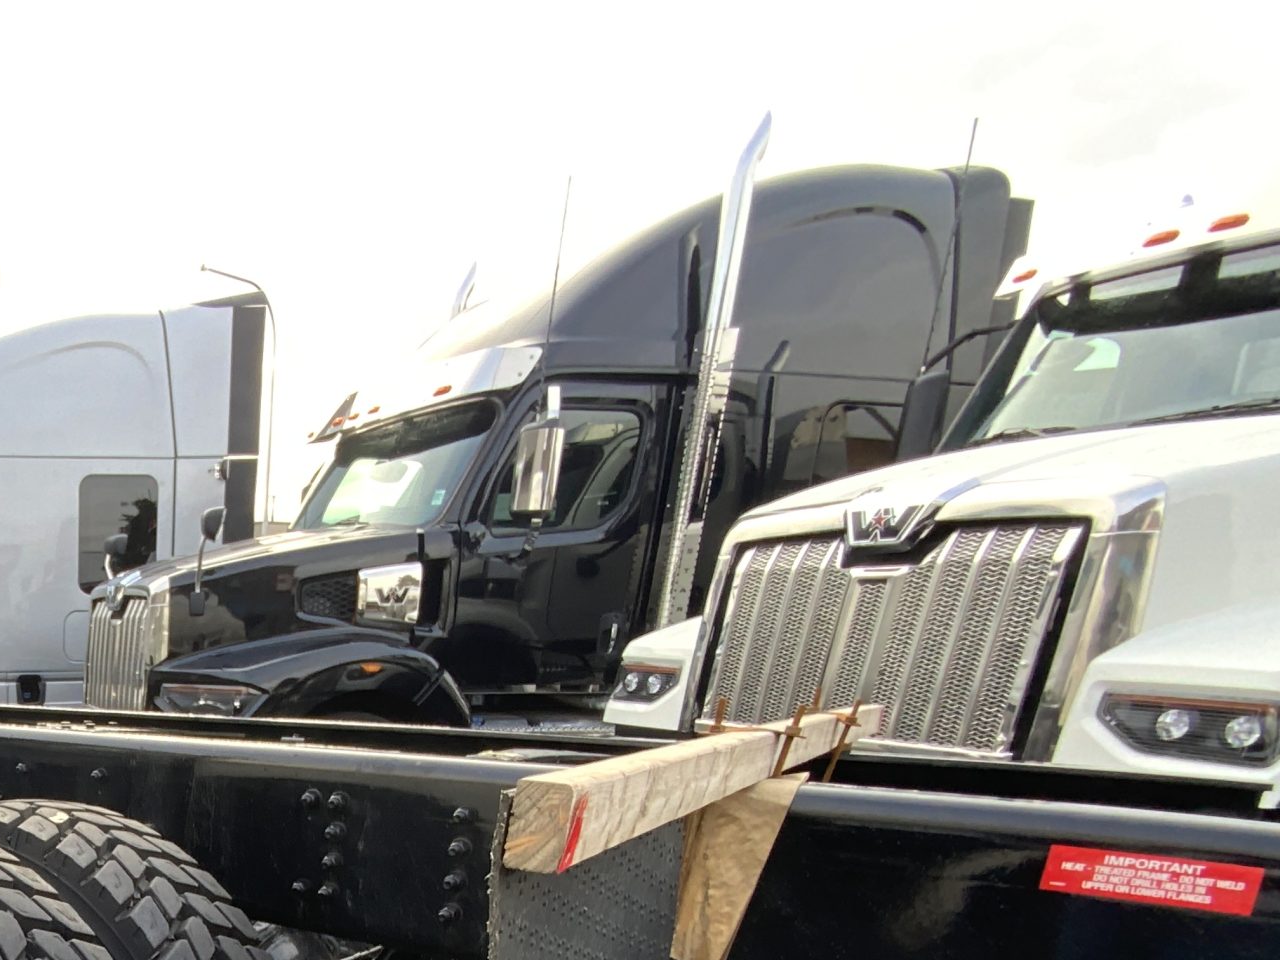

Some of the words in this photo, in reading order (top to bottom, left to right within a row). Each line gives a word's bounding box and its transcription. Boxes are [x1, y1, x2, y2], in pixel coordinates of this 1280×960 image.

[1104, 855, 1205, 875] IMPORTANT
[1061, 862, 1085, 871] HEAT
[1094, 866, 1135, 877] TREATED
[1195, 878, 1215, 886] NOT
[1216, 880, 1245, 890] WELD
[1109, 876, 1128, 884] NOT
[1081, 881, 1114, 891] UPPER
